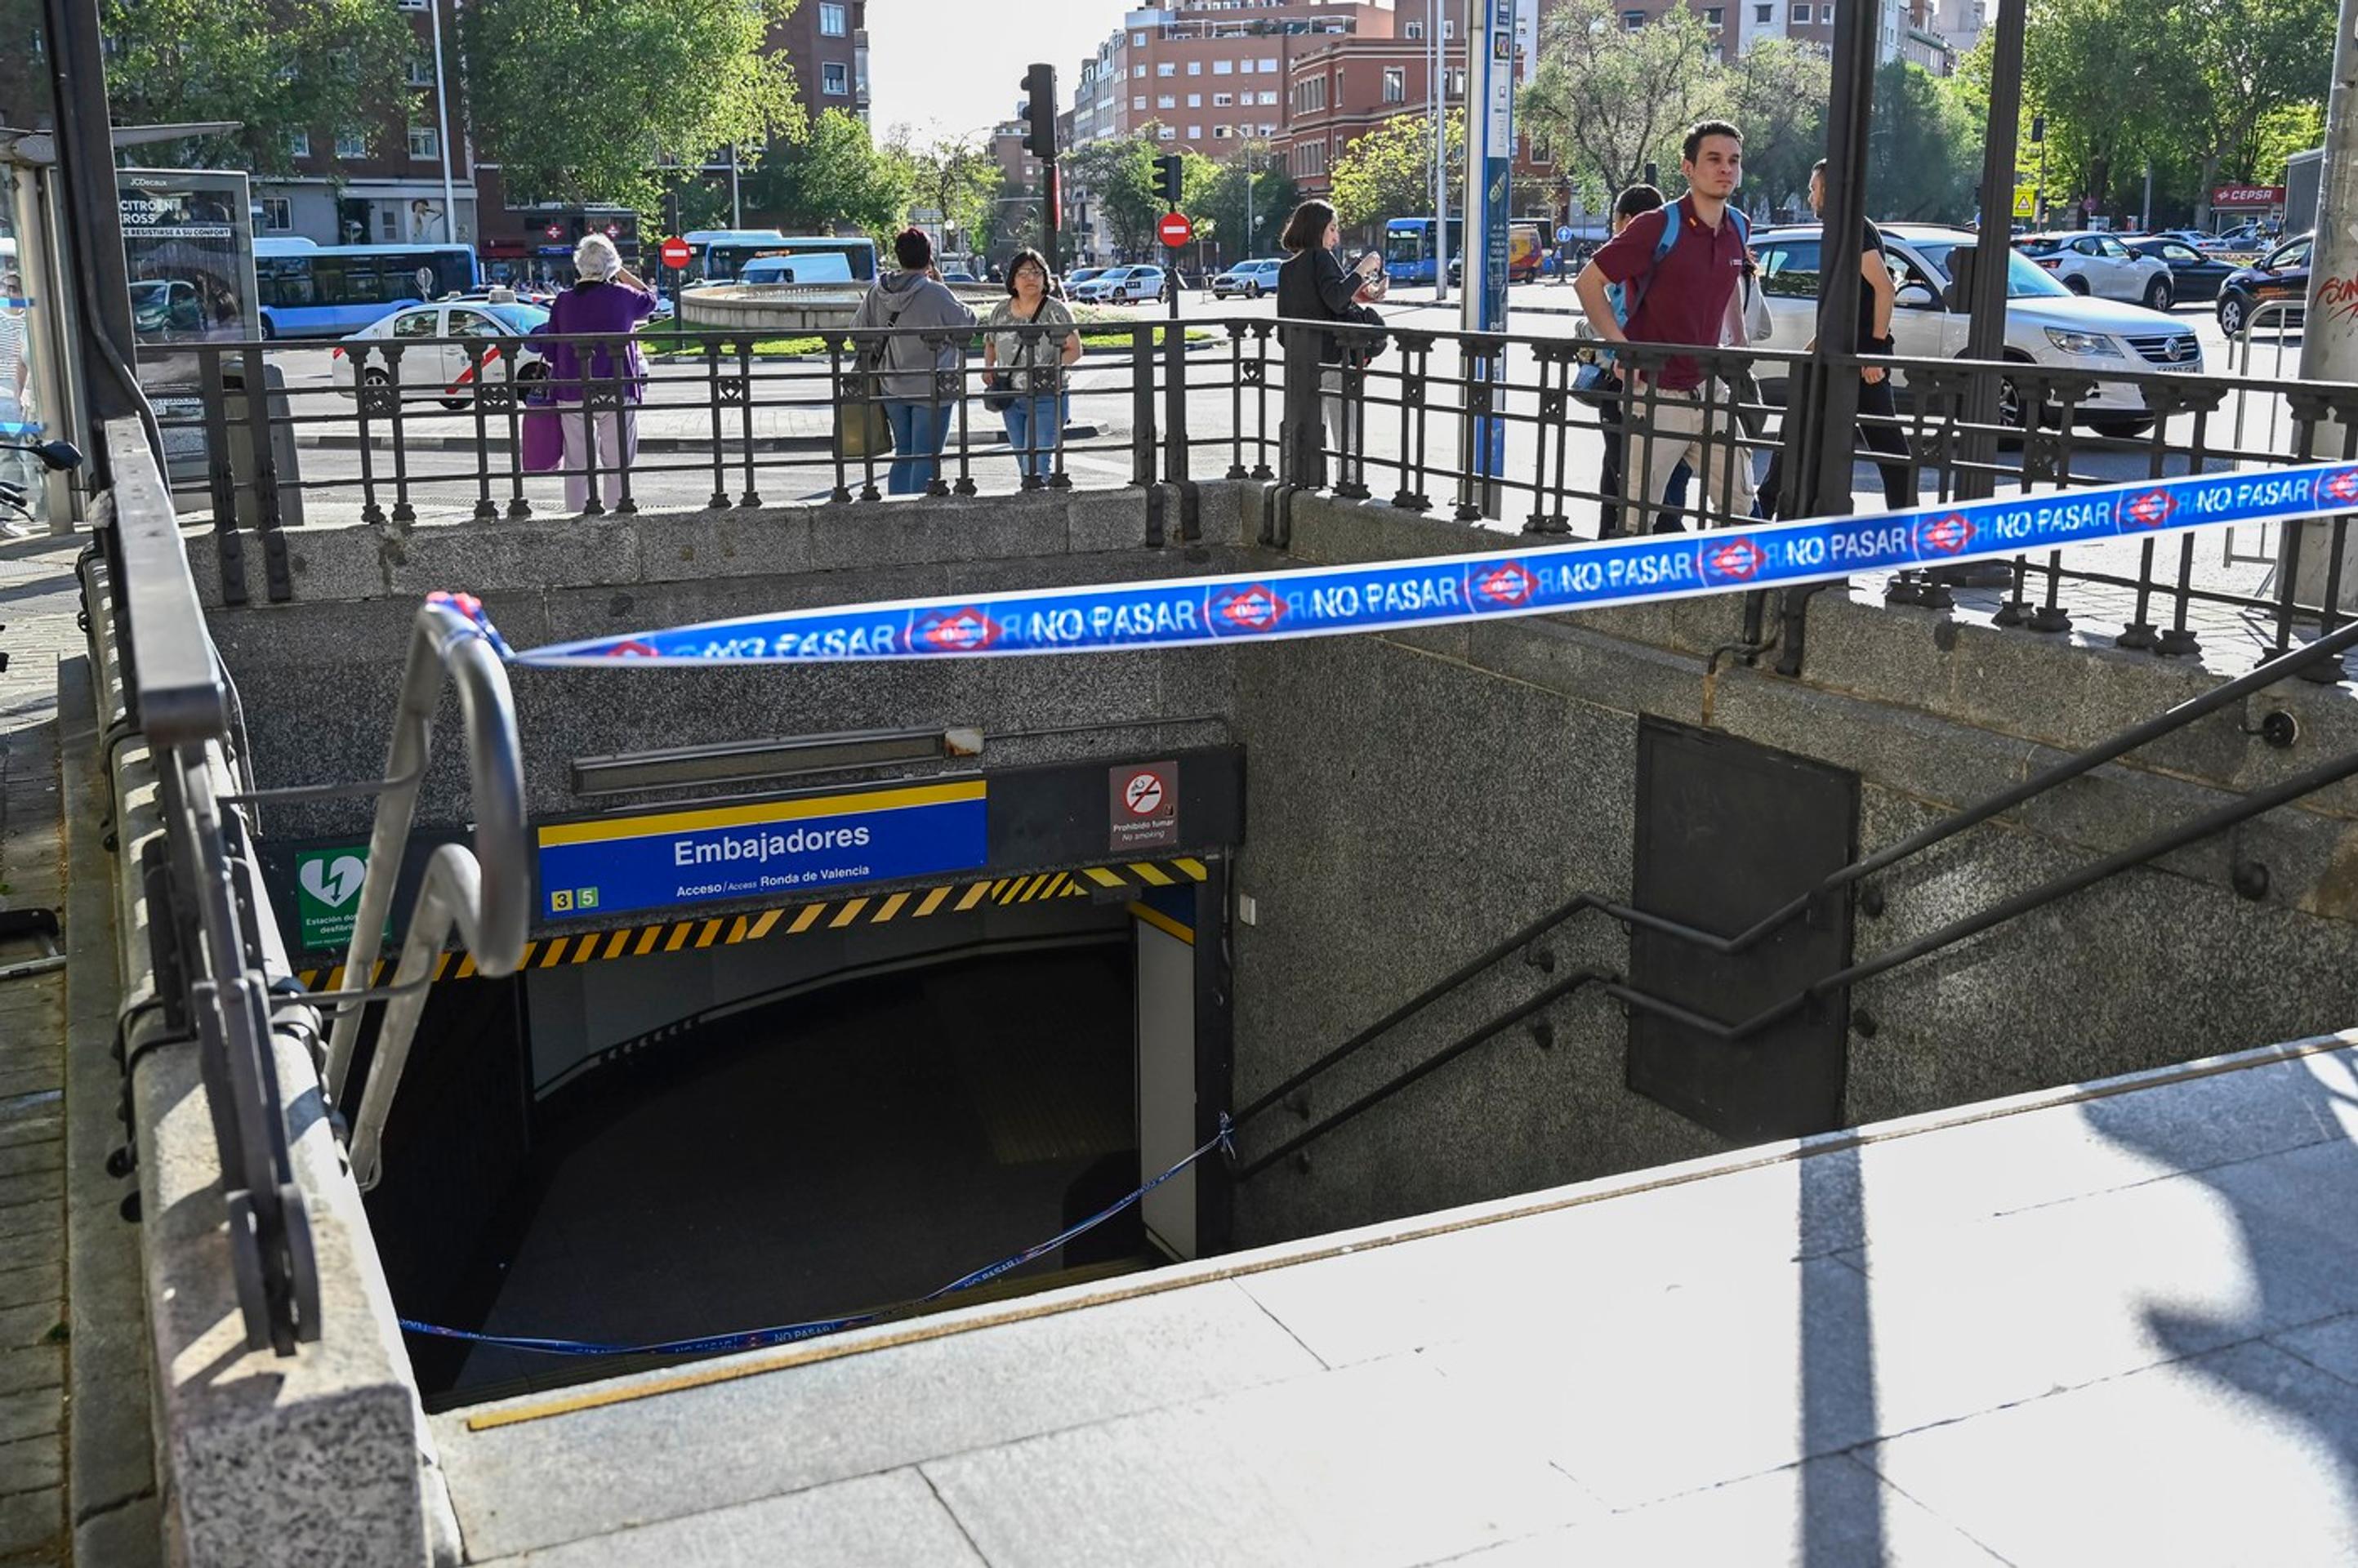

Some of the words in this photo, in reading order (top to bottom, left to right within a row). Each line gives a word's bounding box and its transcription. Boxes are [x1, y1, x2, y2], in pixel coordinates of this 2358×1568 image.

[2231, 189, 2274, 200] CEPSA
[120, 212, 156, 225] ROSS
[2196, 483, 2232, 513] NO
[2237, 477, 2311, 508] PASAR
[1995, 510, 2032, 539] NO
[2039, 501, 2111, 531] PASAR
[1786, 536, 1824, 565] NO
[1831, 527, 1907, 560] PASAR
[1559, 560, 1603, 592] NO
[1609, 551, 1693, 586] PASAR
[1311, 586, 1359, 618] NO
[1366, 576, 1460, 612] PASAR
[1032, 609, 1084, 642] NO
[1093, 599, 1197, 636] PASAR
[1113, 821, 1151, 832] Prohibido
[1152, 819, 1174, 828] fumar
[1121, 833, 1133, 842] No
[1135, 831, 1166, 840] smoking
[674, 825, 871, 866] Embajadores
[760, 874, 800, 888] Ronda
[802, 871, 818, 882] de
[820, 865, 870, 880] Valencia
[557, 893, 568, 908] 3
[582, 889, 595, 906] 5
[306, 915, 342, 925] Estación
